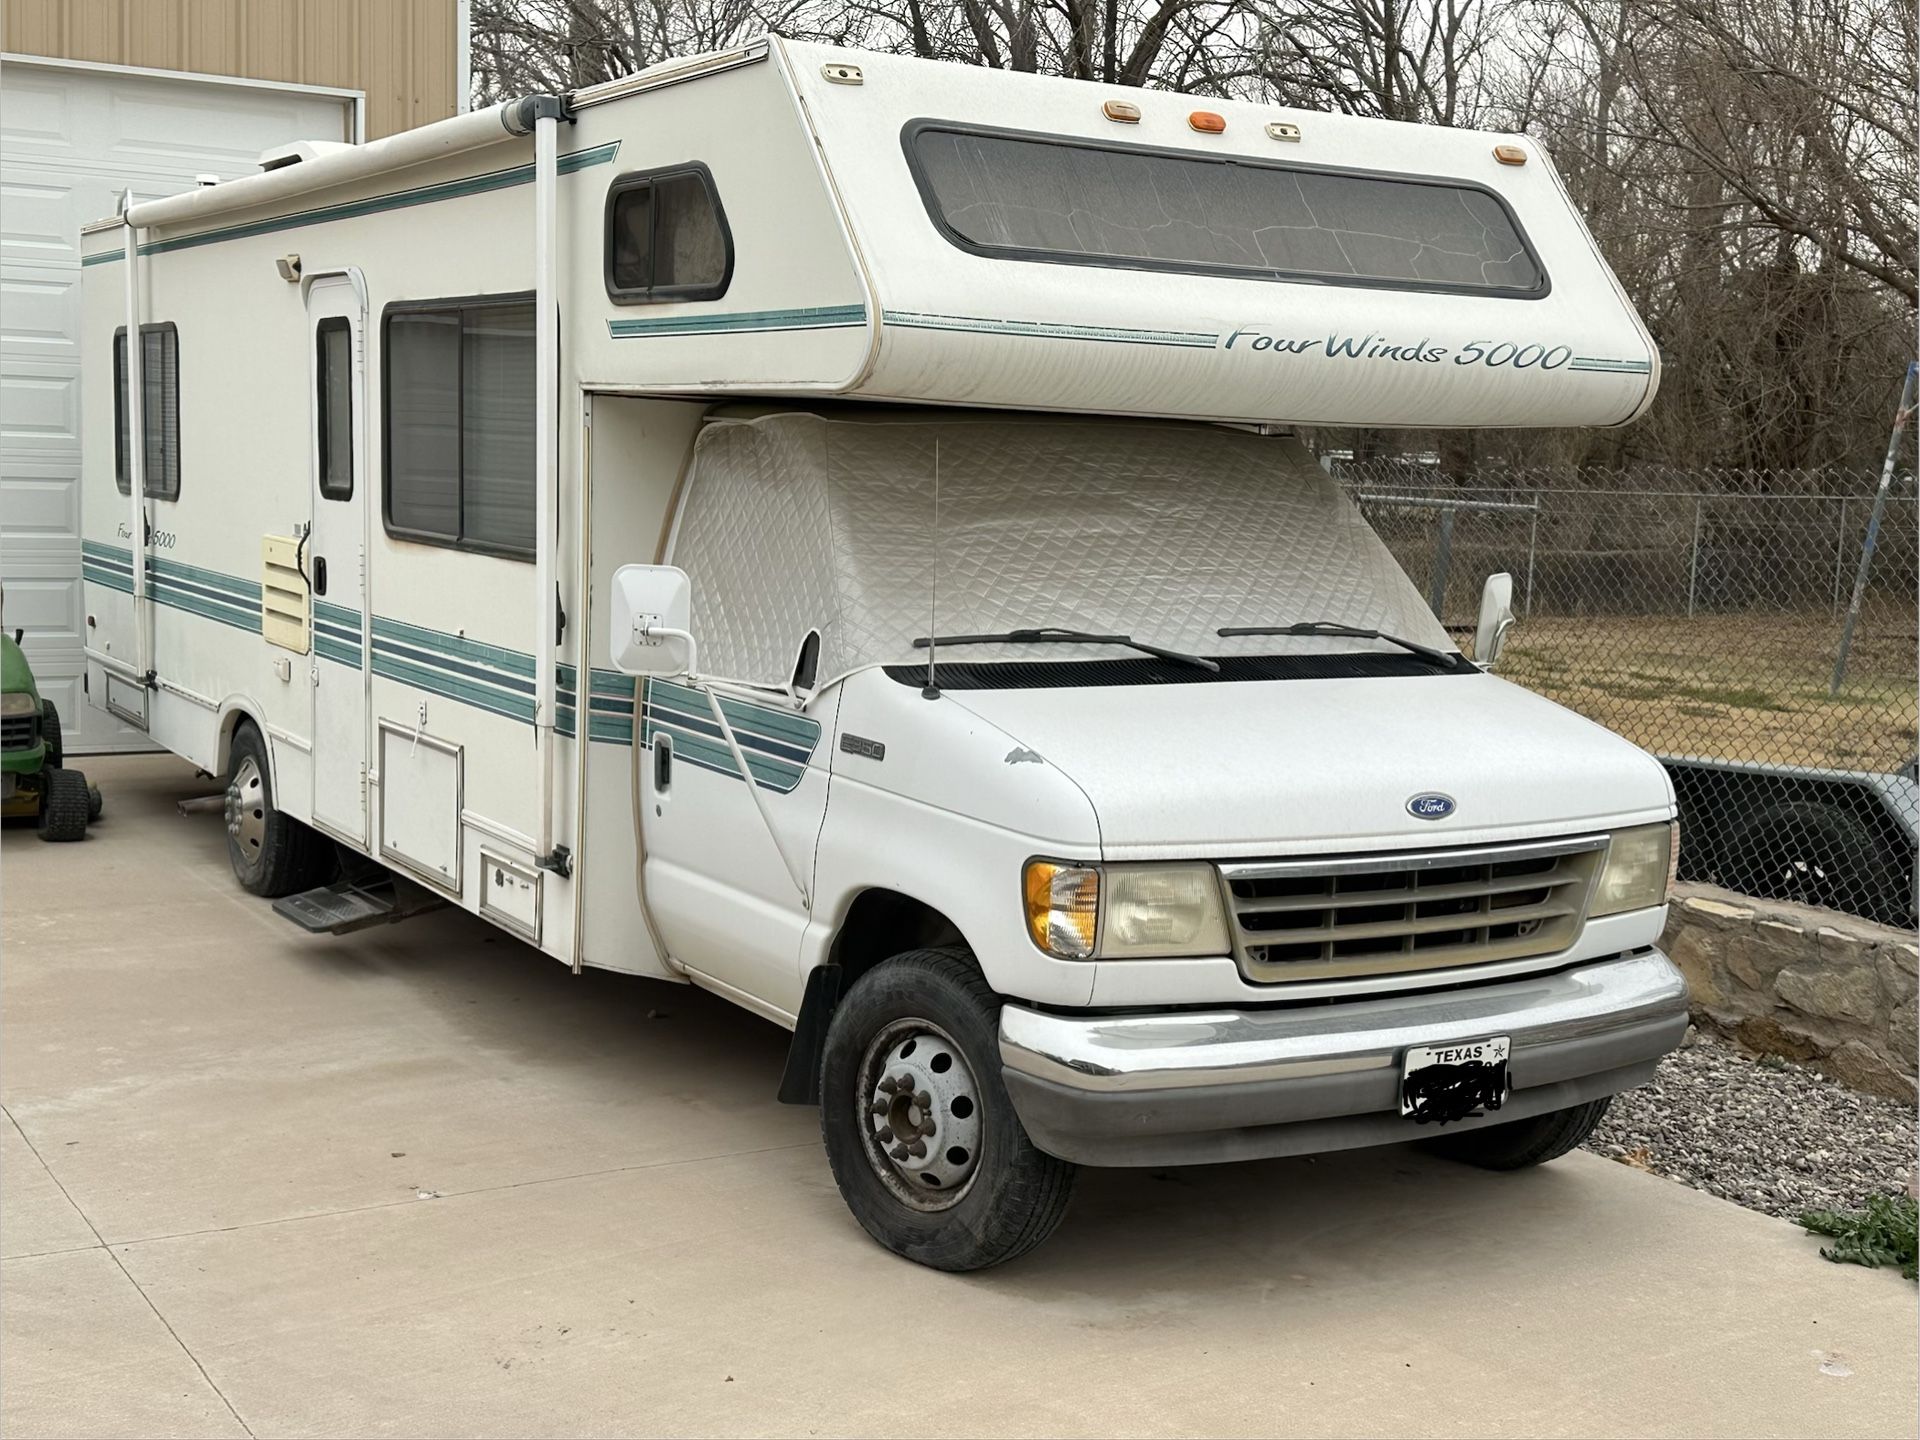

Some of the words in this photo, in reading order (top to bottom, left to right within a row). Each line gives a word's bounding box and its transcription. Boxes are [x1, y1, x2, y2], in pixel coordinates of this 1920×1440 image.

[1224, 324, 1321, 355] Four
[1324, 331, 1448, 363] Winds
[1453, 340, 1572, 370] 5000
[118, 522, 133, 539] Four
[153, 530, 176, 549] 5000
[1419, 799, 1445, 812] Ford
[1434, 1046, 1483, 1063] TEXAS
